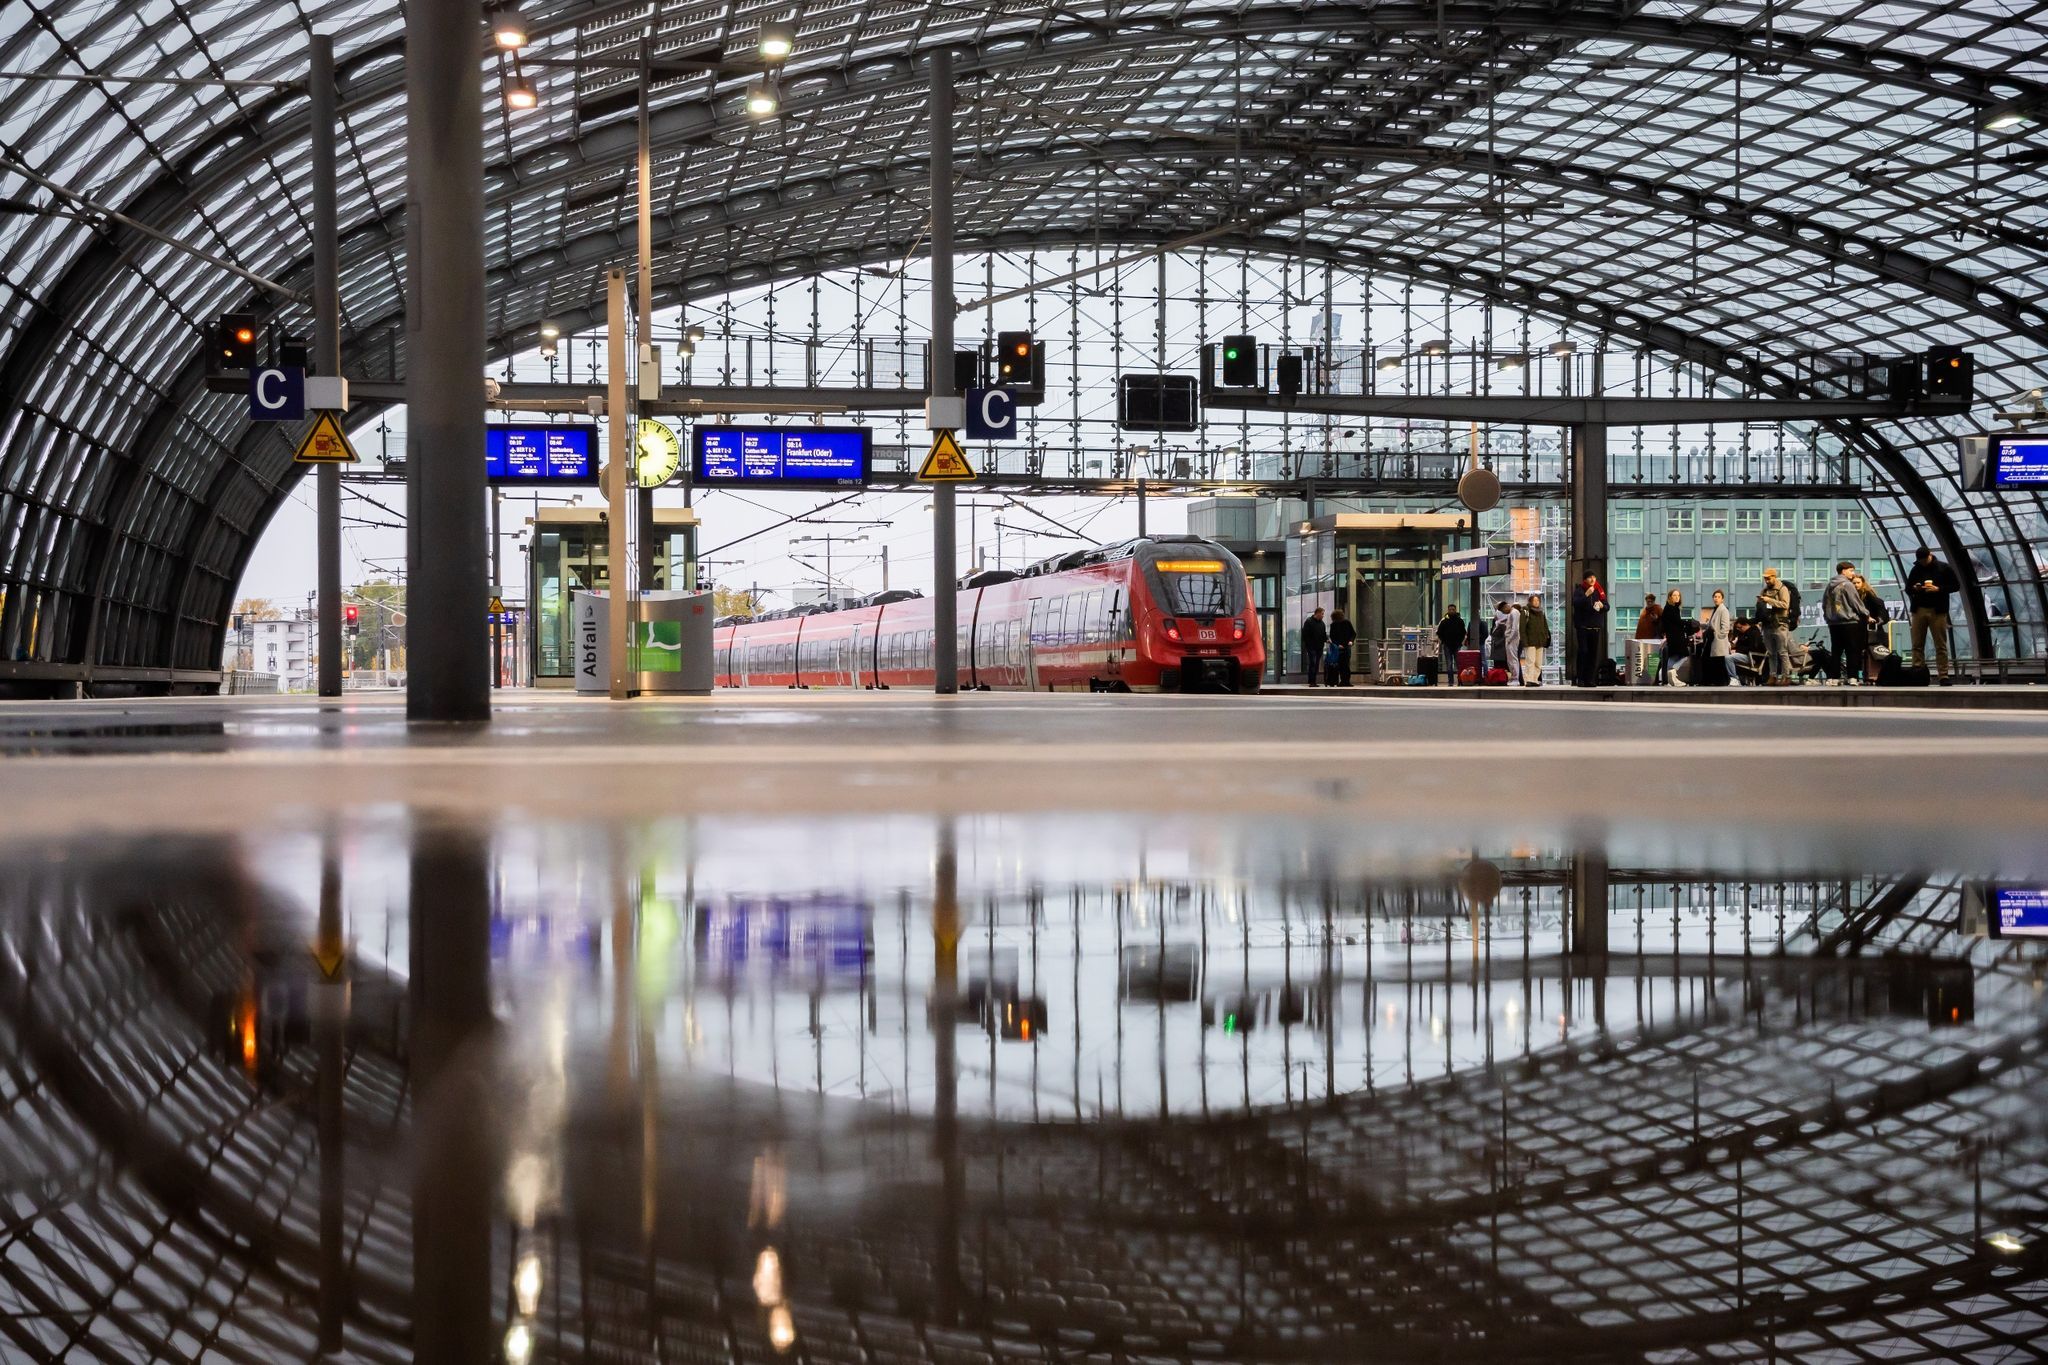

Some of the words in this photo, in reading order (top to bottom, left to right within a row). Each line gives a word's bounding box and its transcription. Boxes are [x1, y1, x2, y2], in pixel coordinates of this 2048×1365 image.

[256, 369, 287, 409] C
[982, 390, 1010, 428] C
[813, 449, 832, 457] (Oder)
[1442, 565, 1453, 575] Berlin
[1453, 562, 1477, 575] Hauptbahnhof
[1200, 630, 1215, 639] DB
[583, 621, 597, 677] Abfall
